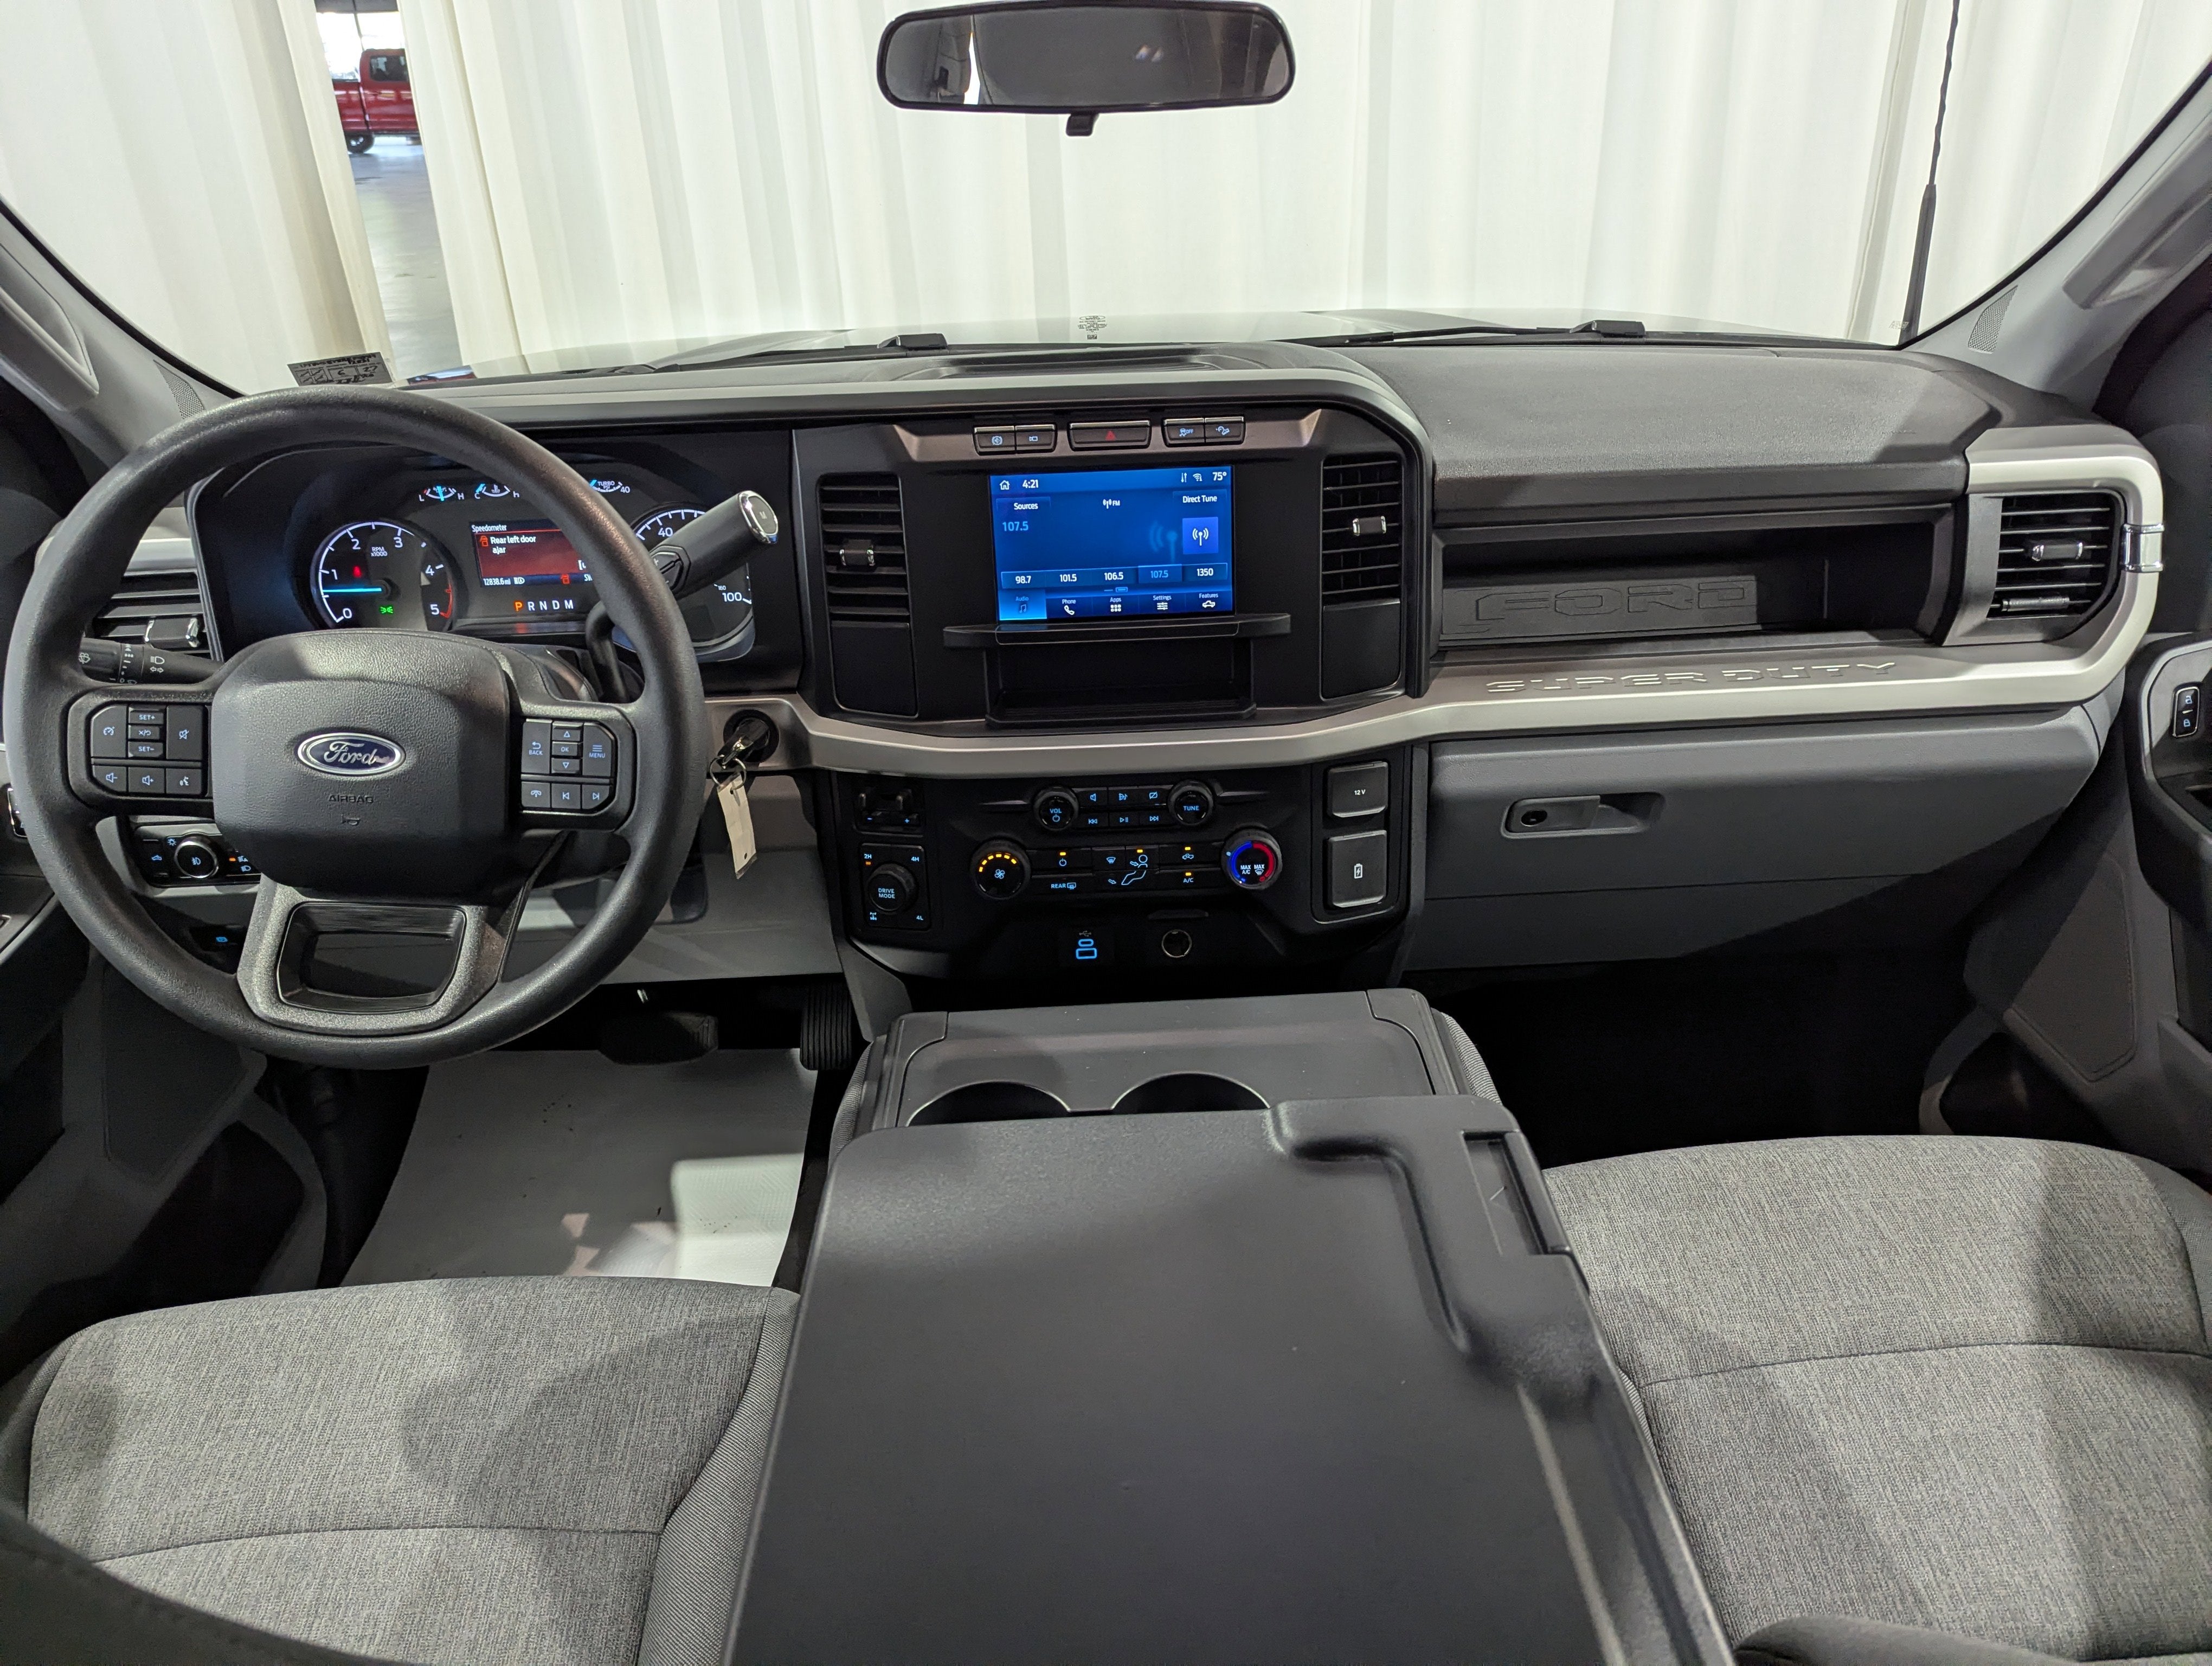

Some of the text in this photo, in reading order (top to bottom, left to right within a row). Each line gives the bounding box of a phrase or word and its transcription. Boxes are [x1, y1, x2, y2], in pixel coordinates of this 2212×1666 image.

[1023, 479, 1039, 488] 4:21
[471, 524, 507, 533] Speedometer
[1002, 521, 1029, 531] 107.5
[658, 527, 673, 537] 40
[351, 539, 361, 550] 2
[394, 537, 403, 548] 3
[490, 535, 537, 544] Rear left door
[492, 546, 506, 555] ajar
[331, 569, 338, 580] 1
[425, 565, 435, 576] 4
[1150, 570, 1169, 579] 107.5
[1197, 568, 1214, 576] 1350
[1015, 575, 1032, 584] 98.7
[1059, 574, 1077, 582] 101.5
[1104, 572, 1124, 581] 106.5
[722, 592, 742, 602] 100
[1475, 579, 1757, 621] FORD
[430, 604, 440, 615] 5
[515, 599, 574, 612] P R N D M
[342, 608, 352, 619] 0
[1486, 662, 1895, 694] SUPER DUTY
[324, 741, 377, 766] Ford
[328, 794, 375, 804] AIRBAG
